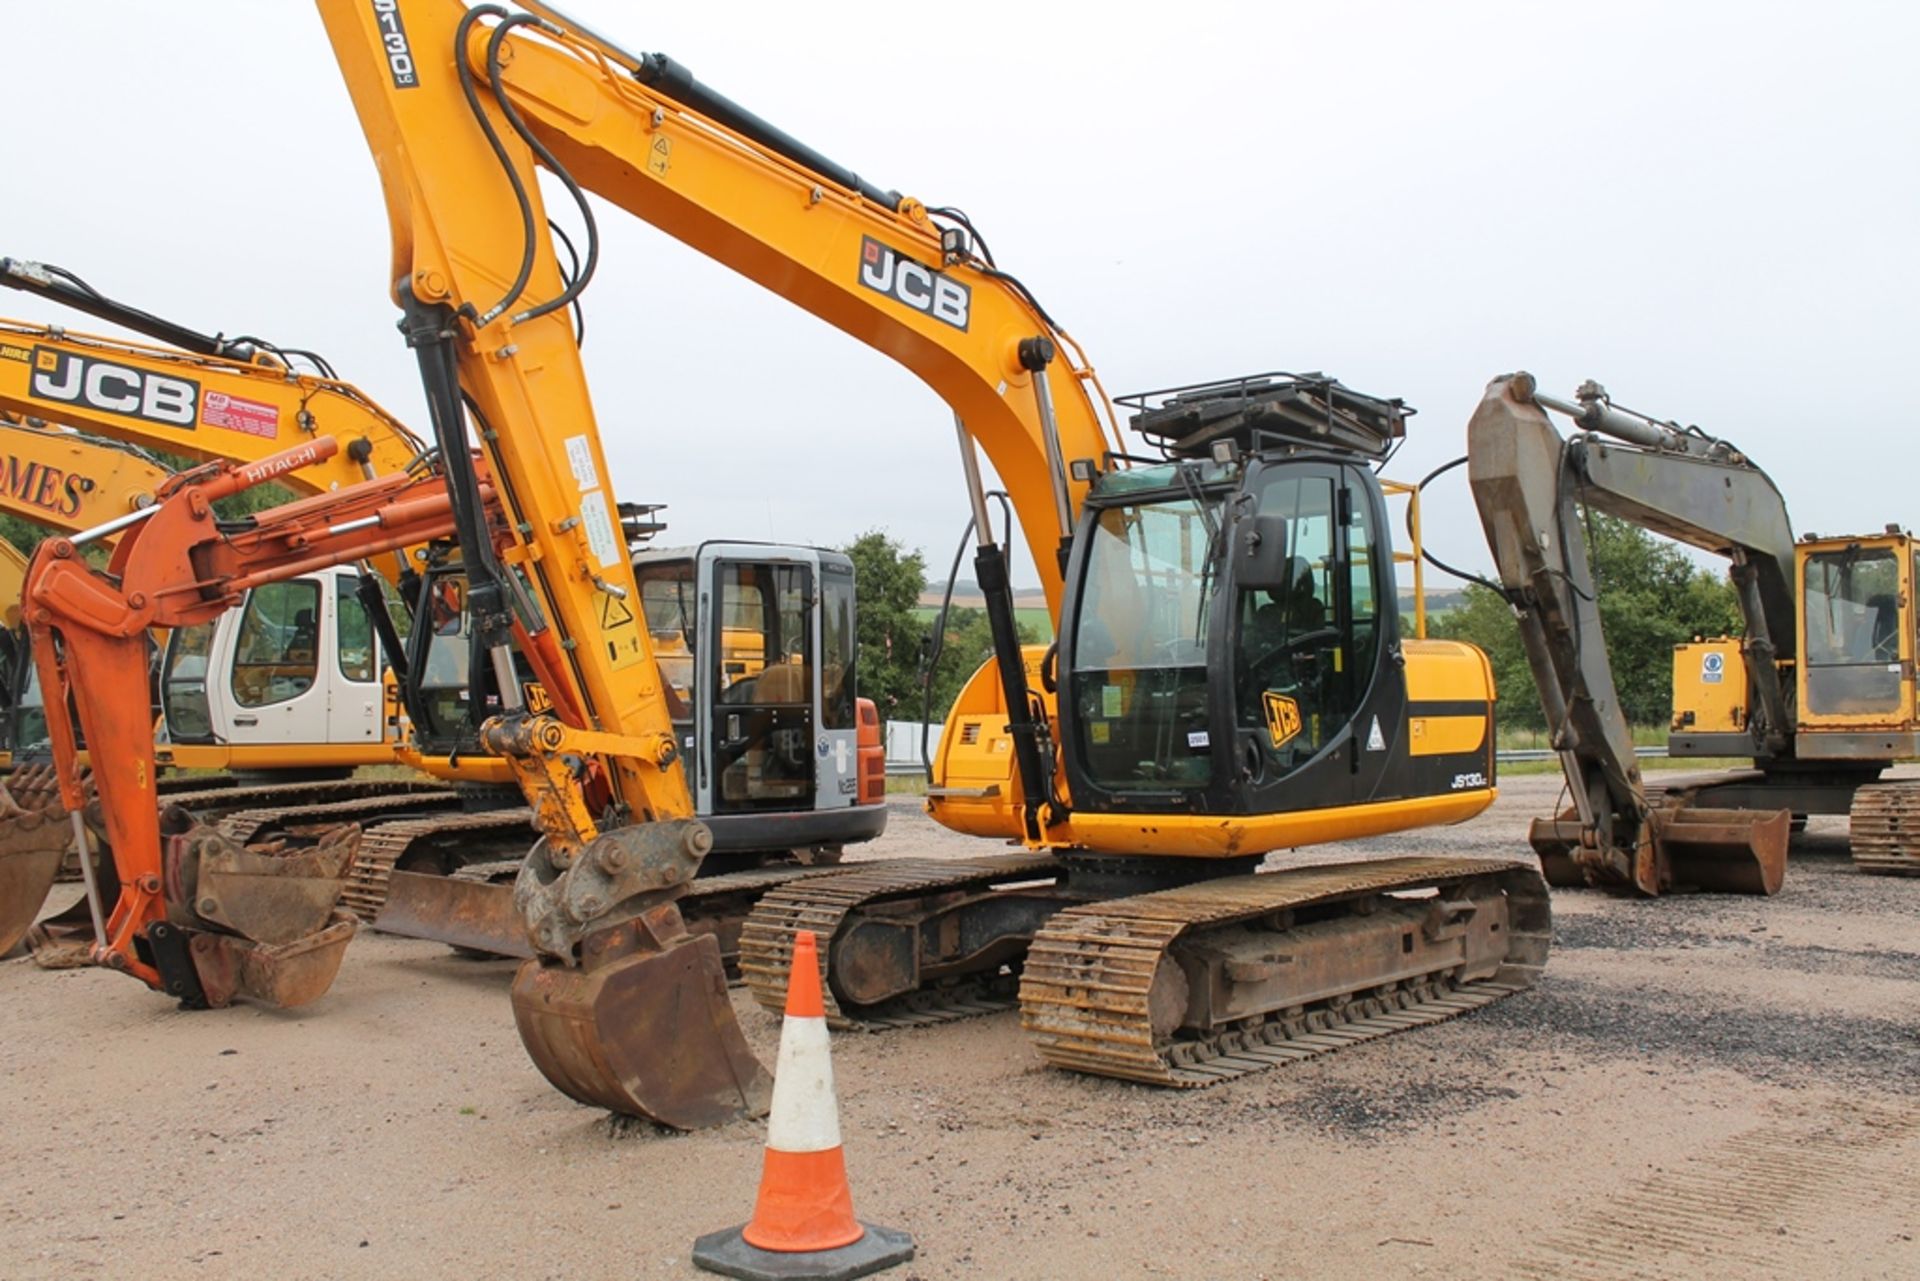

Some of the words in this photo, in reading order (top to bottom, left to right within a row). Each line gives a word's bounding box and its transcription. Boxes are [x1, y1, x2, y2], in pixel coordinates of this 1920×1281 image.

[863, 250, 968, 327] JCB
[1, 346, 30, 361] HIRE
[35, 356, 195, 424] JCB
[0, 455, 81, 518] MES
[246, 447, 316, 483] HITACHI
[1268, 698, 1299, 742] JCB
[1451, 773, 1481, 788] JS130
